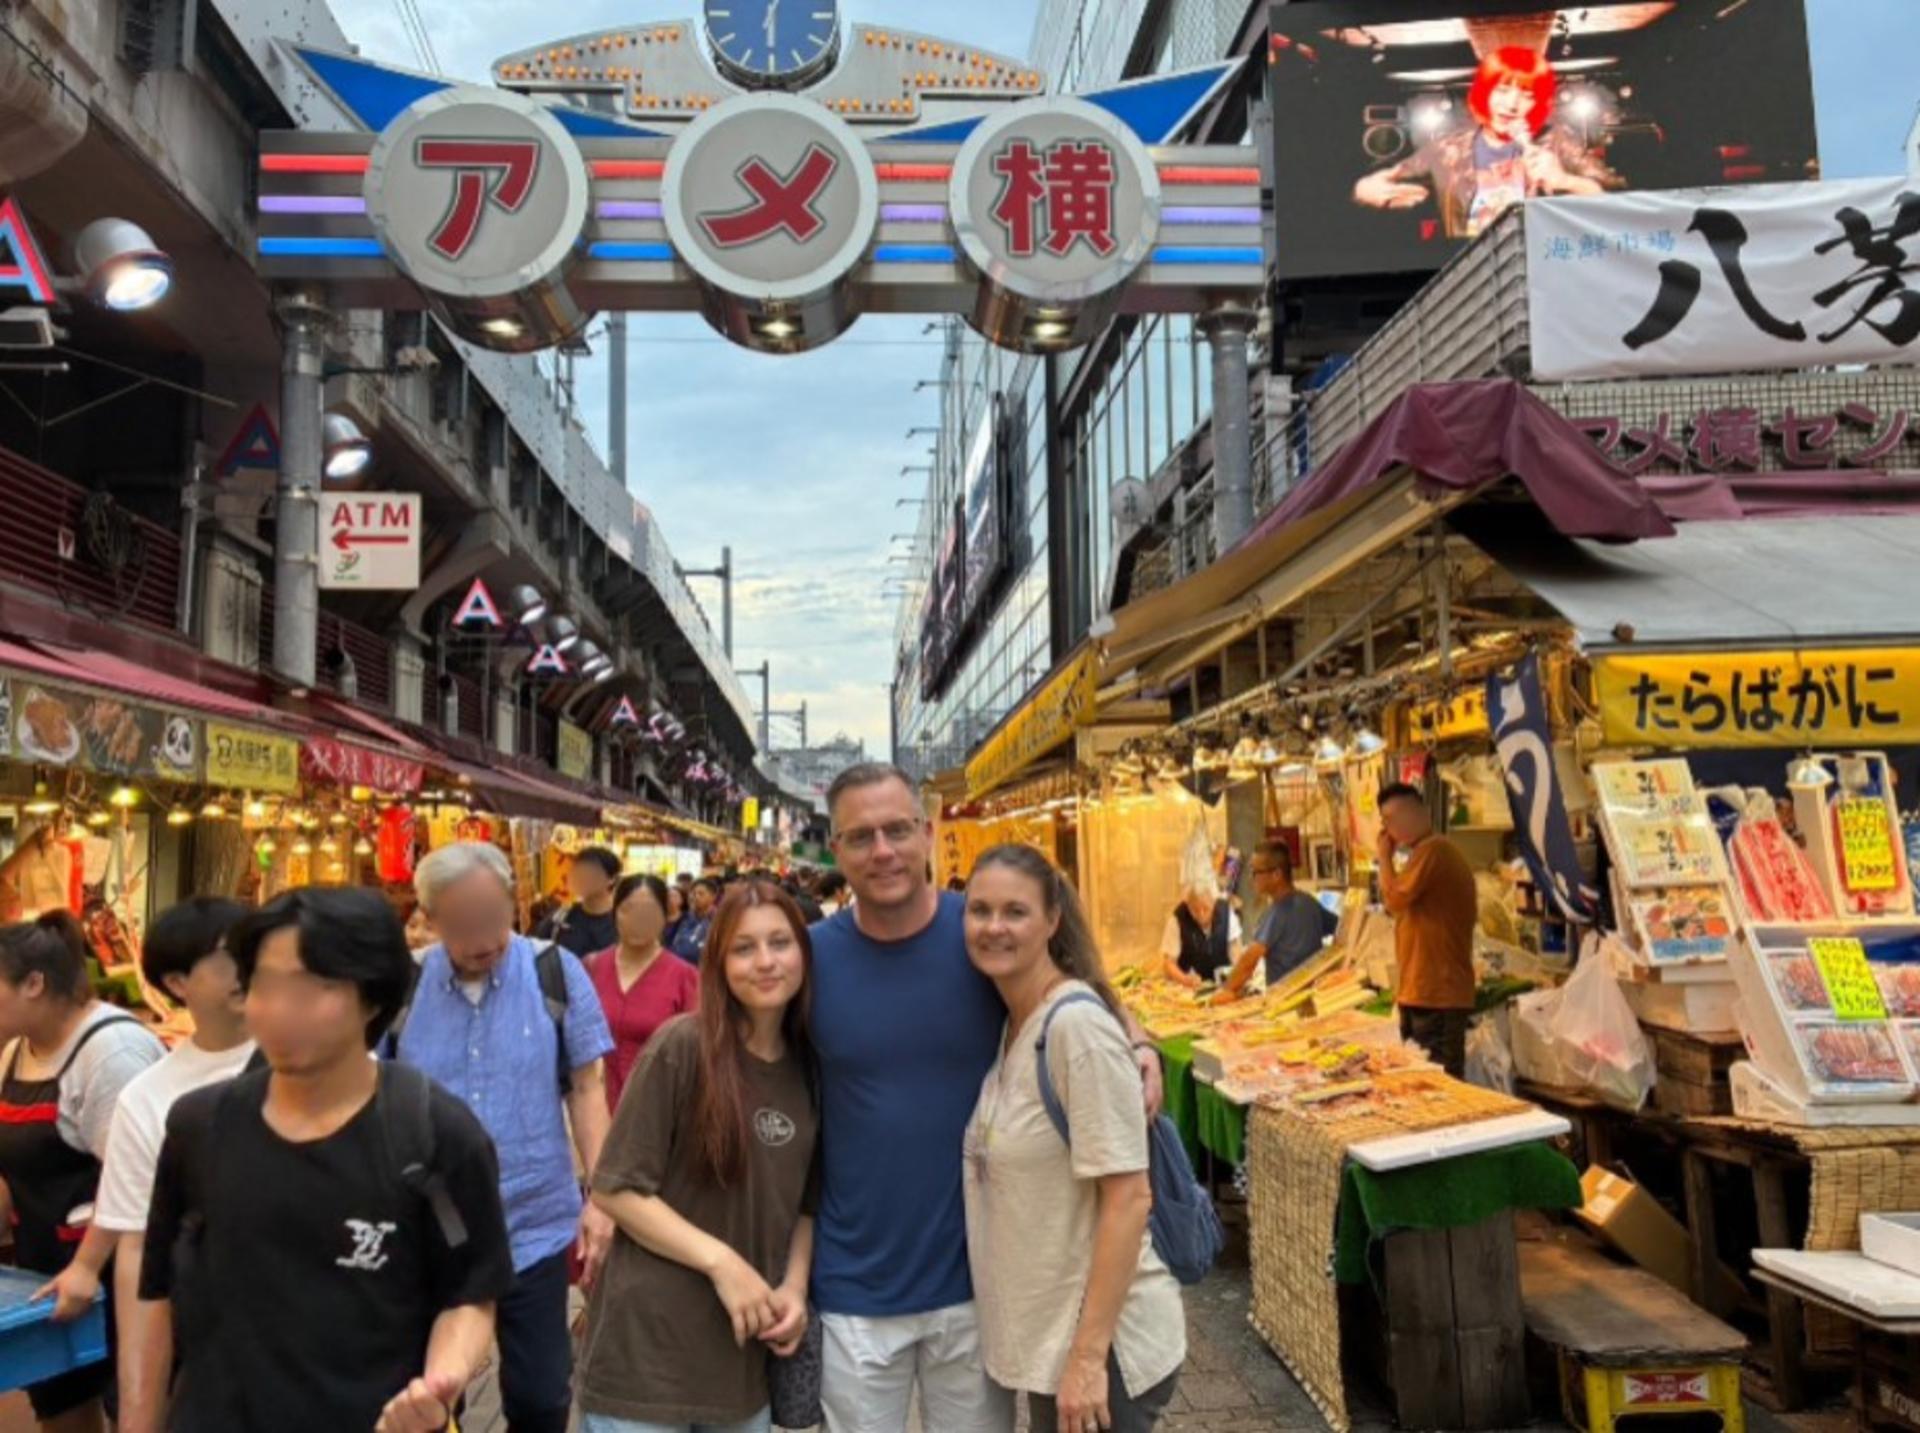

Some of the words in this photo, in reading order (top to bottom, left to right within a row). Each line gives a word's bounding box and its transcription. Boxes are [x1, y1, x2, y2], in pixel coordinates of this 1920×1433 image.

[416, 137, 1117, 260] アメ横
[331, 502, 410, 527] ATM
[1629, 664, 1900, 732] たらばがに
